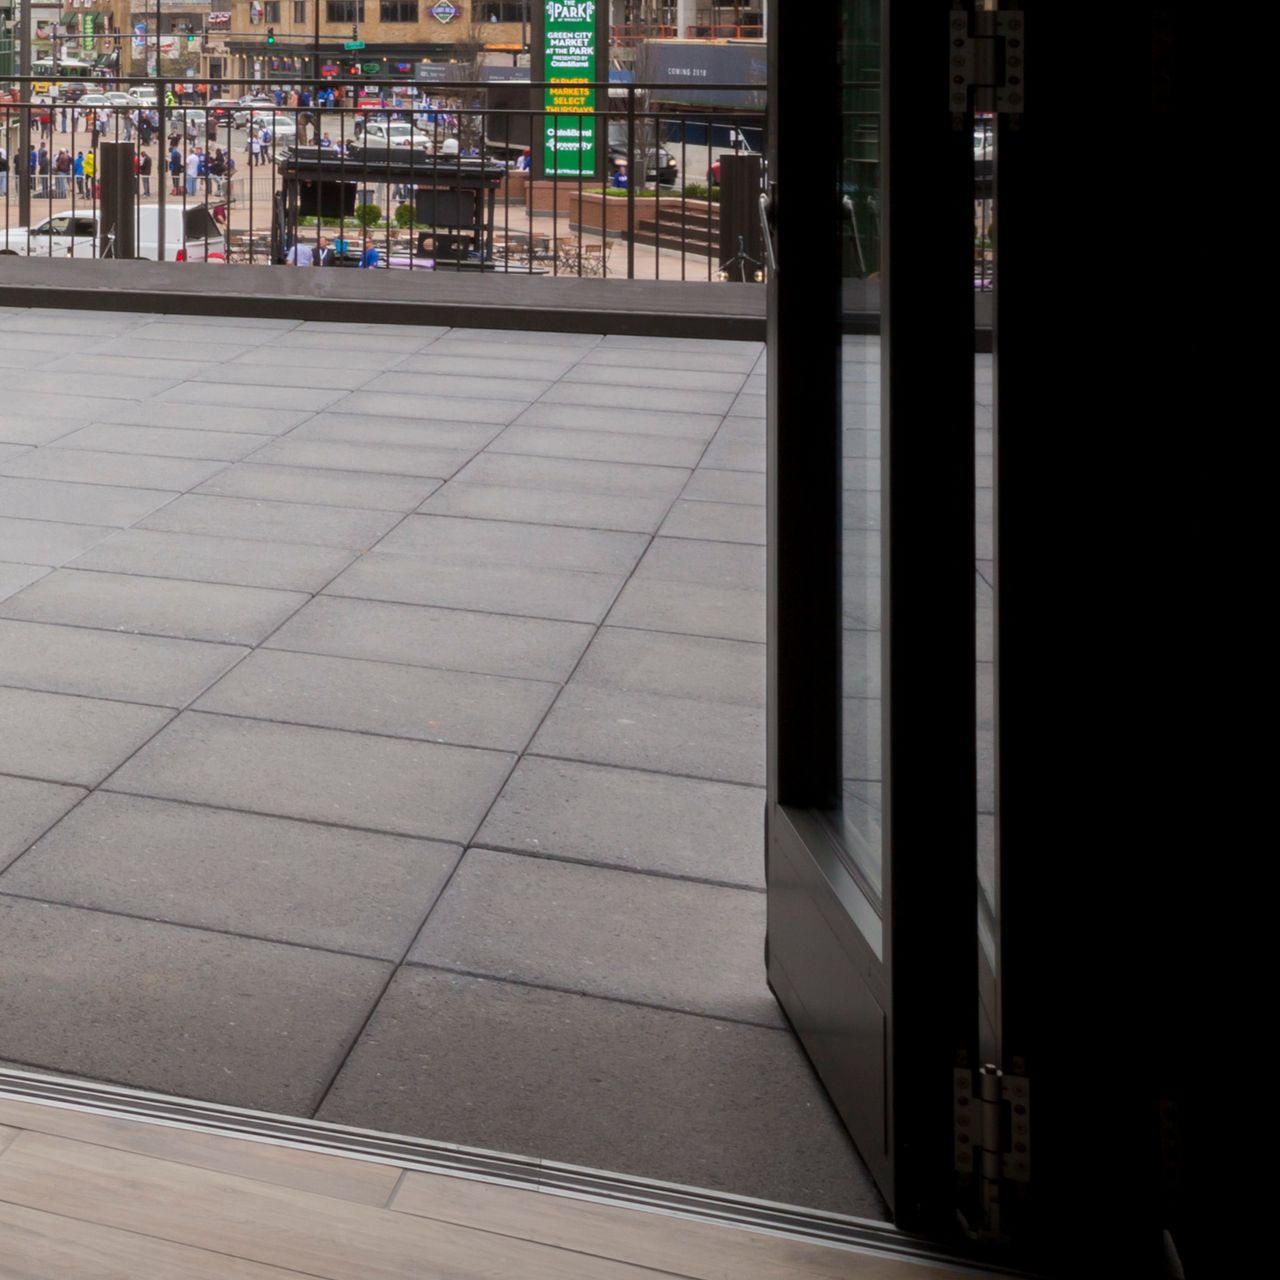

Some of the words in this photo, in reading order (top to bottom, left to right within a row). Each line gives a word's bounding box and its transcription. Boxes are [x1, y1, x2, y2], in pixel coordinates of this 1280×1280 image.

[554, 2, 587, 18] PARK
[550, 39, 589, 47] MARKET
[569, 47, 594, 55] PARK
[668, 67, 690, 76] COMING
[549, 87, 590, 96] MARKETS
[553, 97, 586, 105] SELECT
